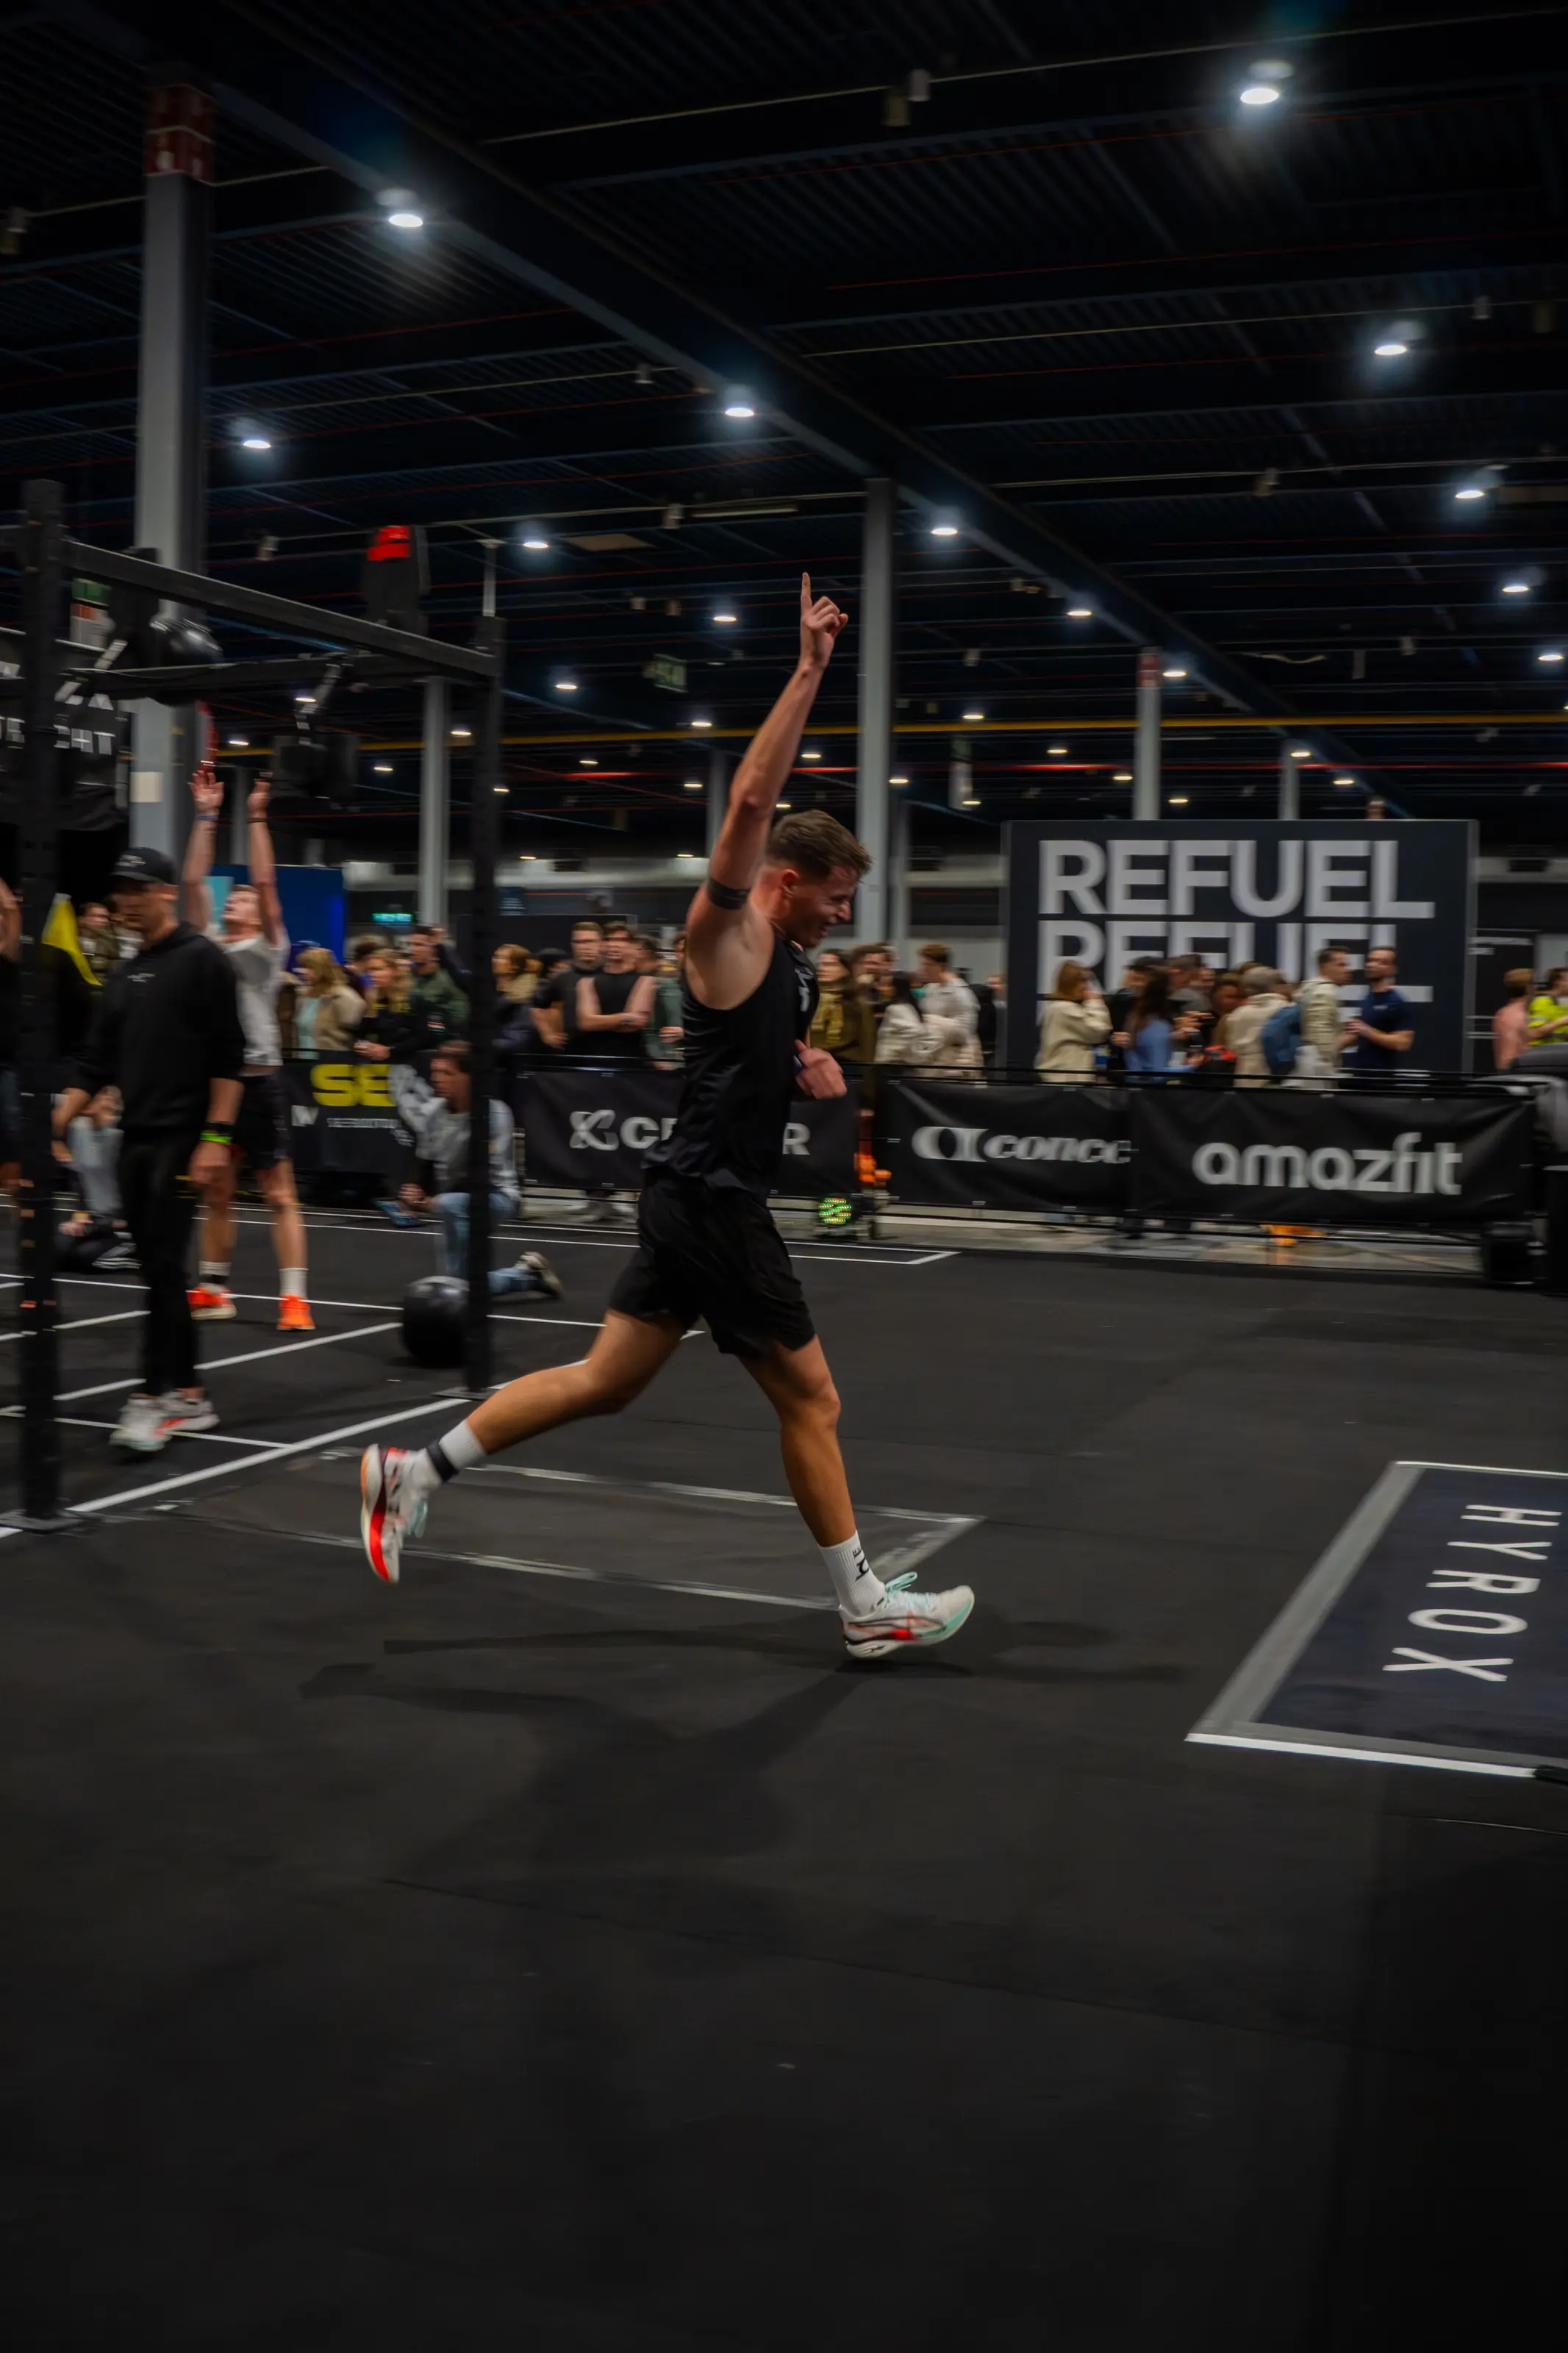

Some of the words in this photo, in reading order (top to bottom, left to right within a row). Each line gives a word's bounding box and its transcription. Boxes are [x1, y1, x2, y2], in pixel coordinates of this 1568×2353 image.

[1037, 839, 1436, 919] REFUEL
[1192, 1132, 1462, 1196] amazfit
[1383, 1504, 1563, 1682] HYROX
